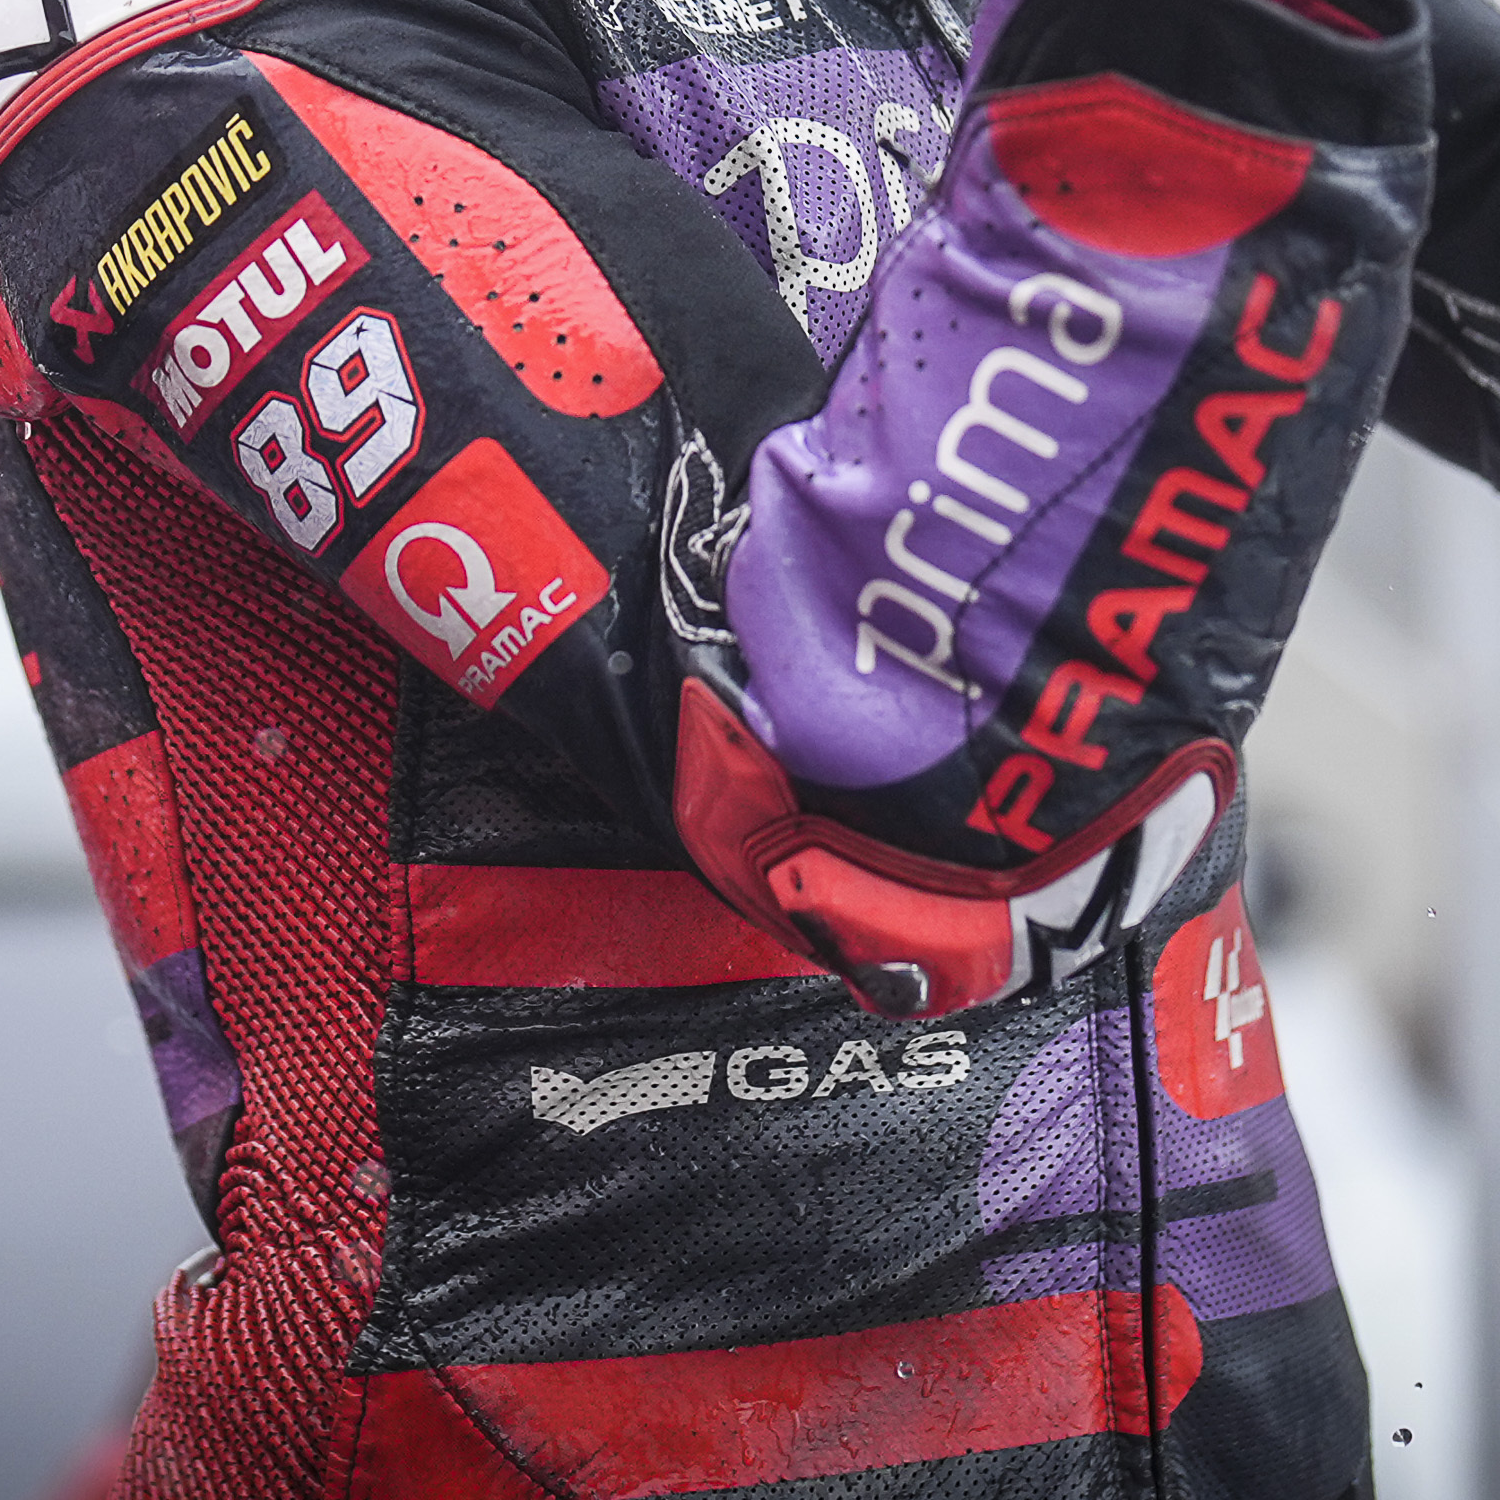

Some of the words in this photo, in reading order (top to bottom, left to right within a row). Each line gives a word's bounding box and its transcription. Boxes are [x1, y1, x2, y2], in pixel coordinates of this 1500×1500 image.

[152, 218, 347, 428] MOTUL
[231, 306, 425, 557] 89
[855, 273, 1122, 700] prima
[965, 273, 1343, 854] PRAMAC
[457, 577, 577, 694] PRAMAC
[726, 1030, 971, 1100] GAS
